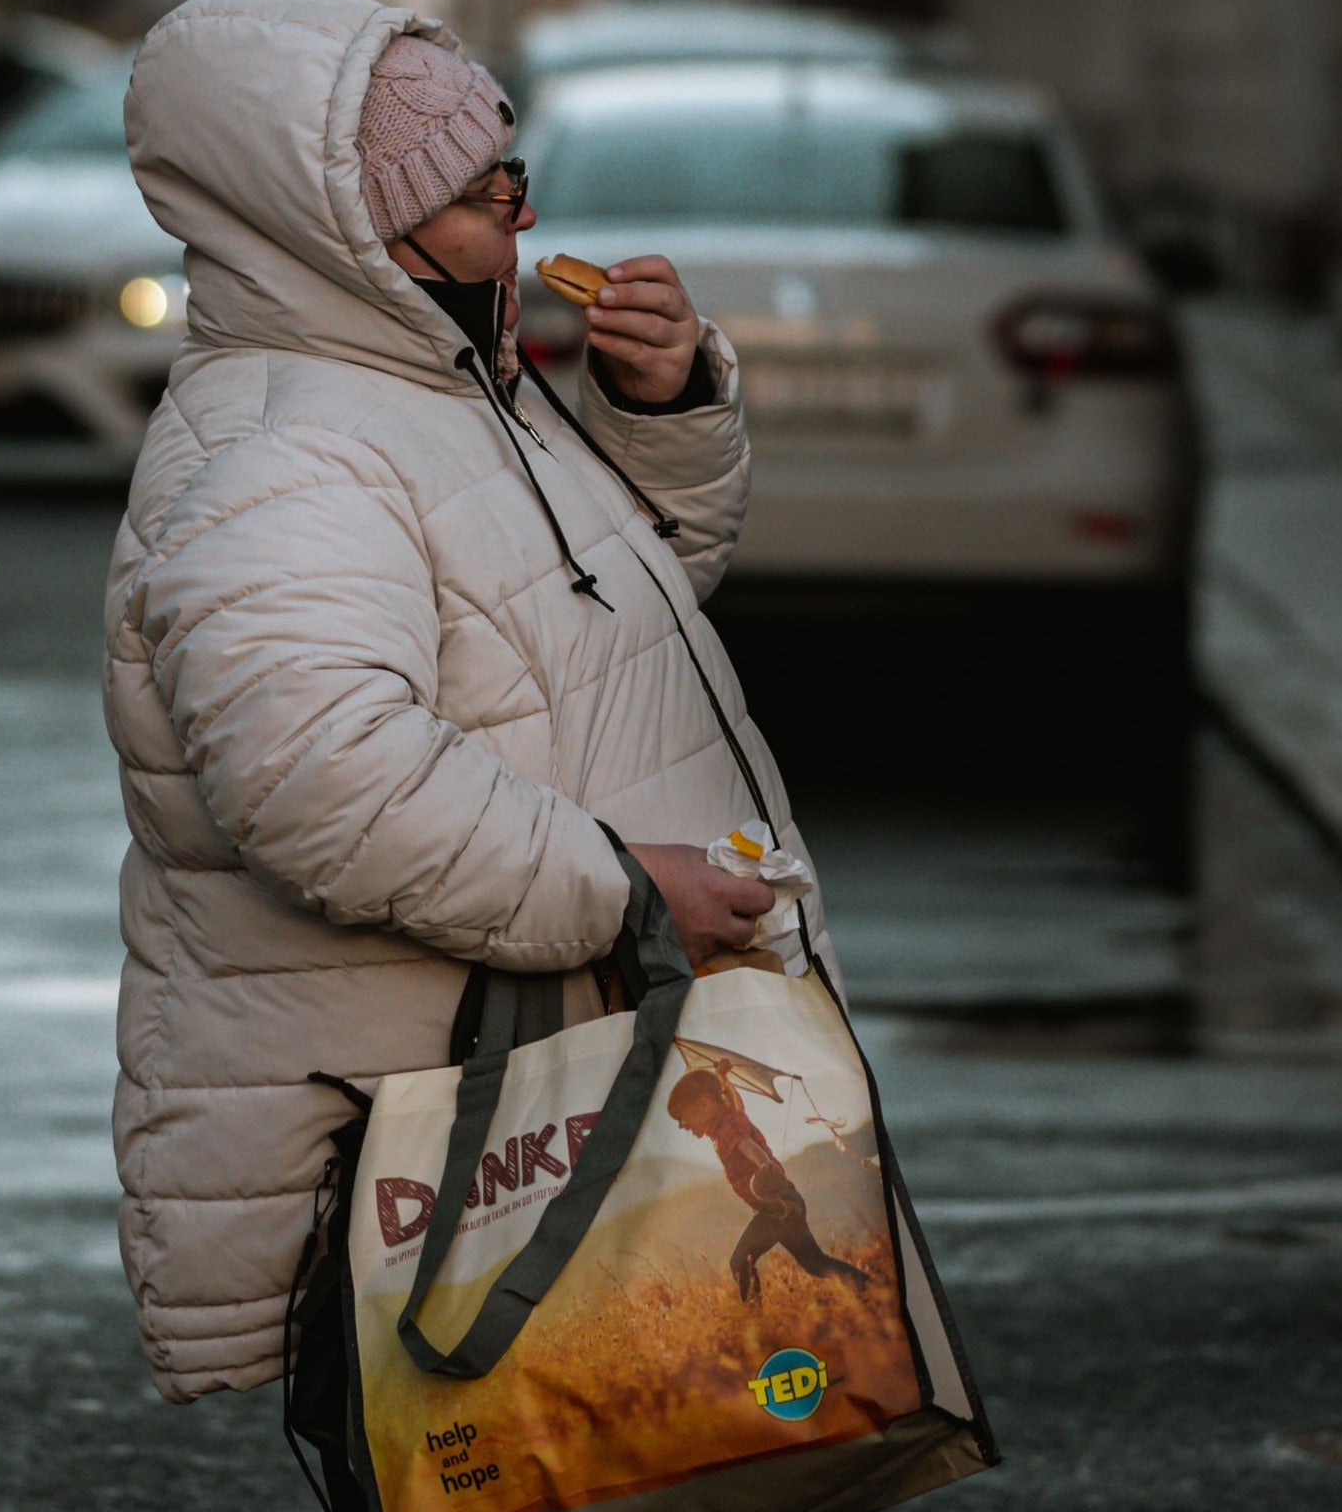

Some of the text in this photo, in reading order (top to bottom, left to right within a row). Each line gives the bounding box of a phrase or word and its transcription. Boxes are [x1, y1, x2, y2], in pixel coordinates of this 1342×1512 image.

[747, 1360, 828, 1406] TEDi
[425, 1421, 477, 1453] help
[441, 1449, 470, 1468] and
[440, 1463, 500, 1494] hope
